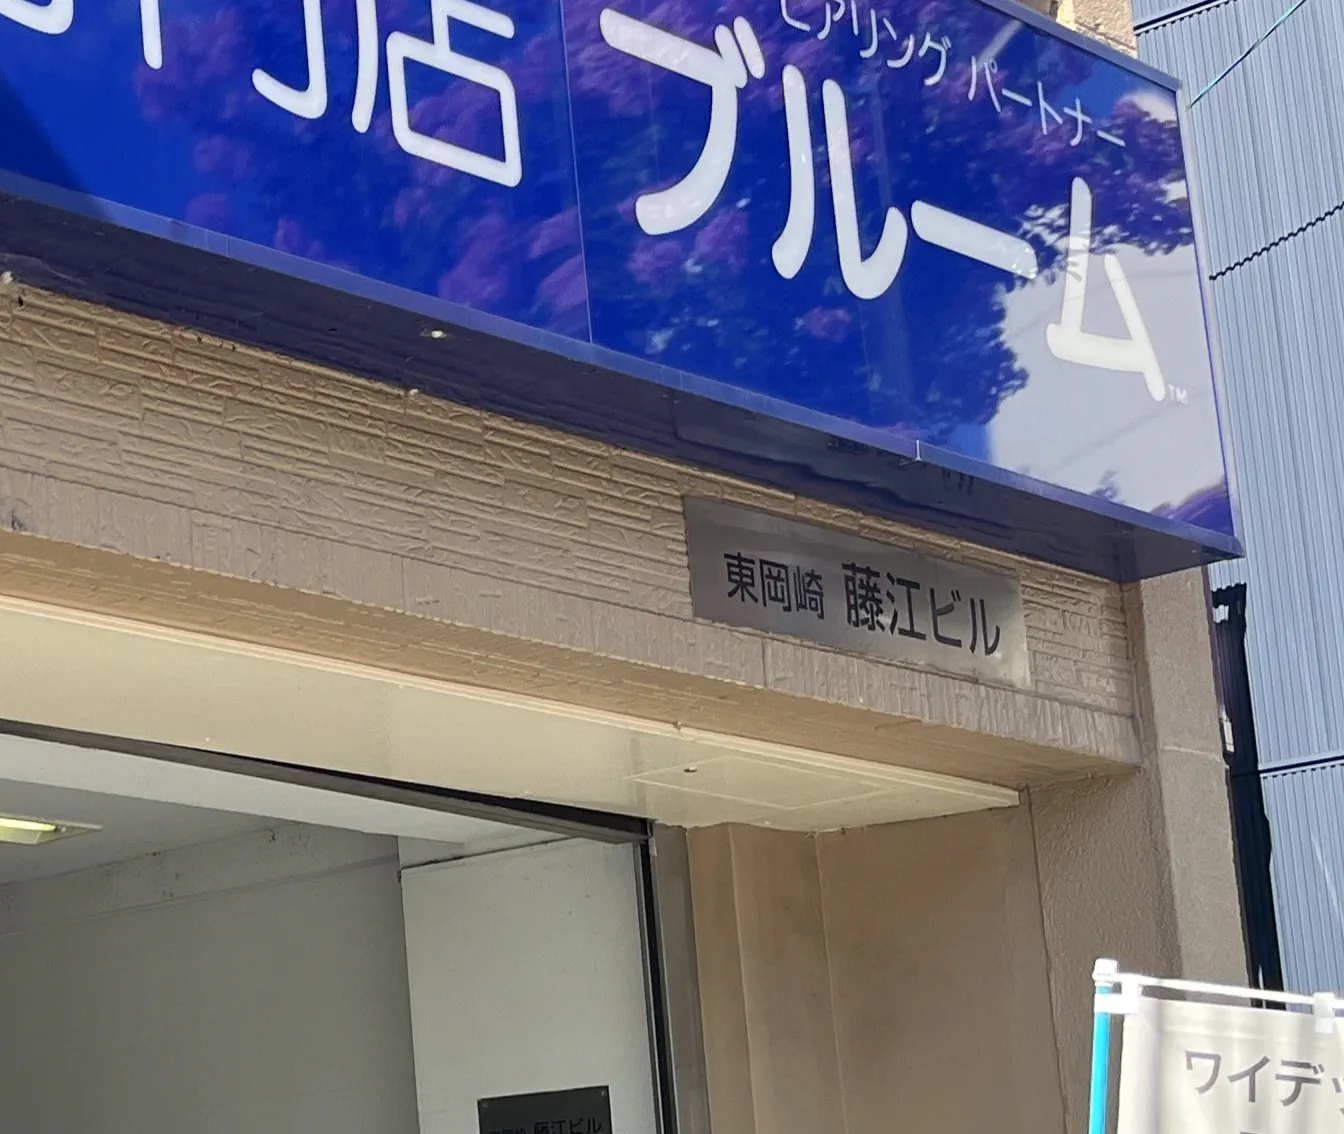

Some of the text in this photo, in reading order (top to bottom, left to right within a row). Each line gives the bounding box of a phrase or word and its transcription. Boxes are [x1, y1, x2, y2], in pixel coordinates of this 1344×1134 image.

[968, 55, 1125, 147] パートナー
[599, 8, 1166, 402] ブルーム
[723, 551, 1001, 657] 東岡崎 藤江ビル
